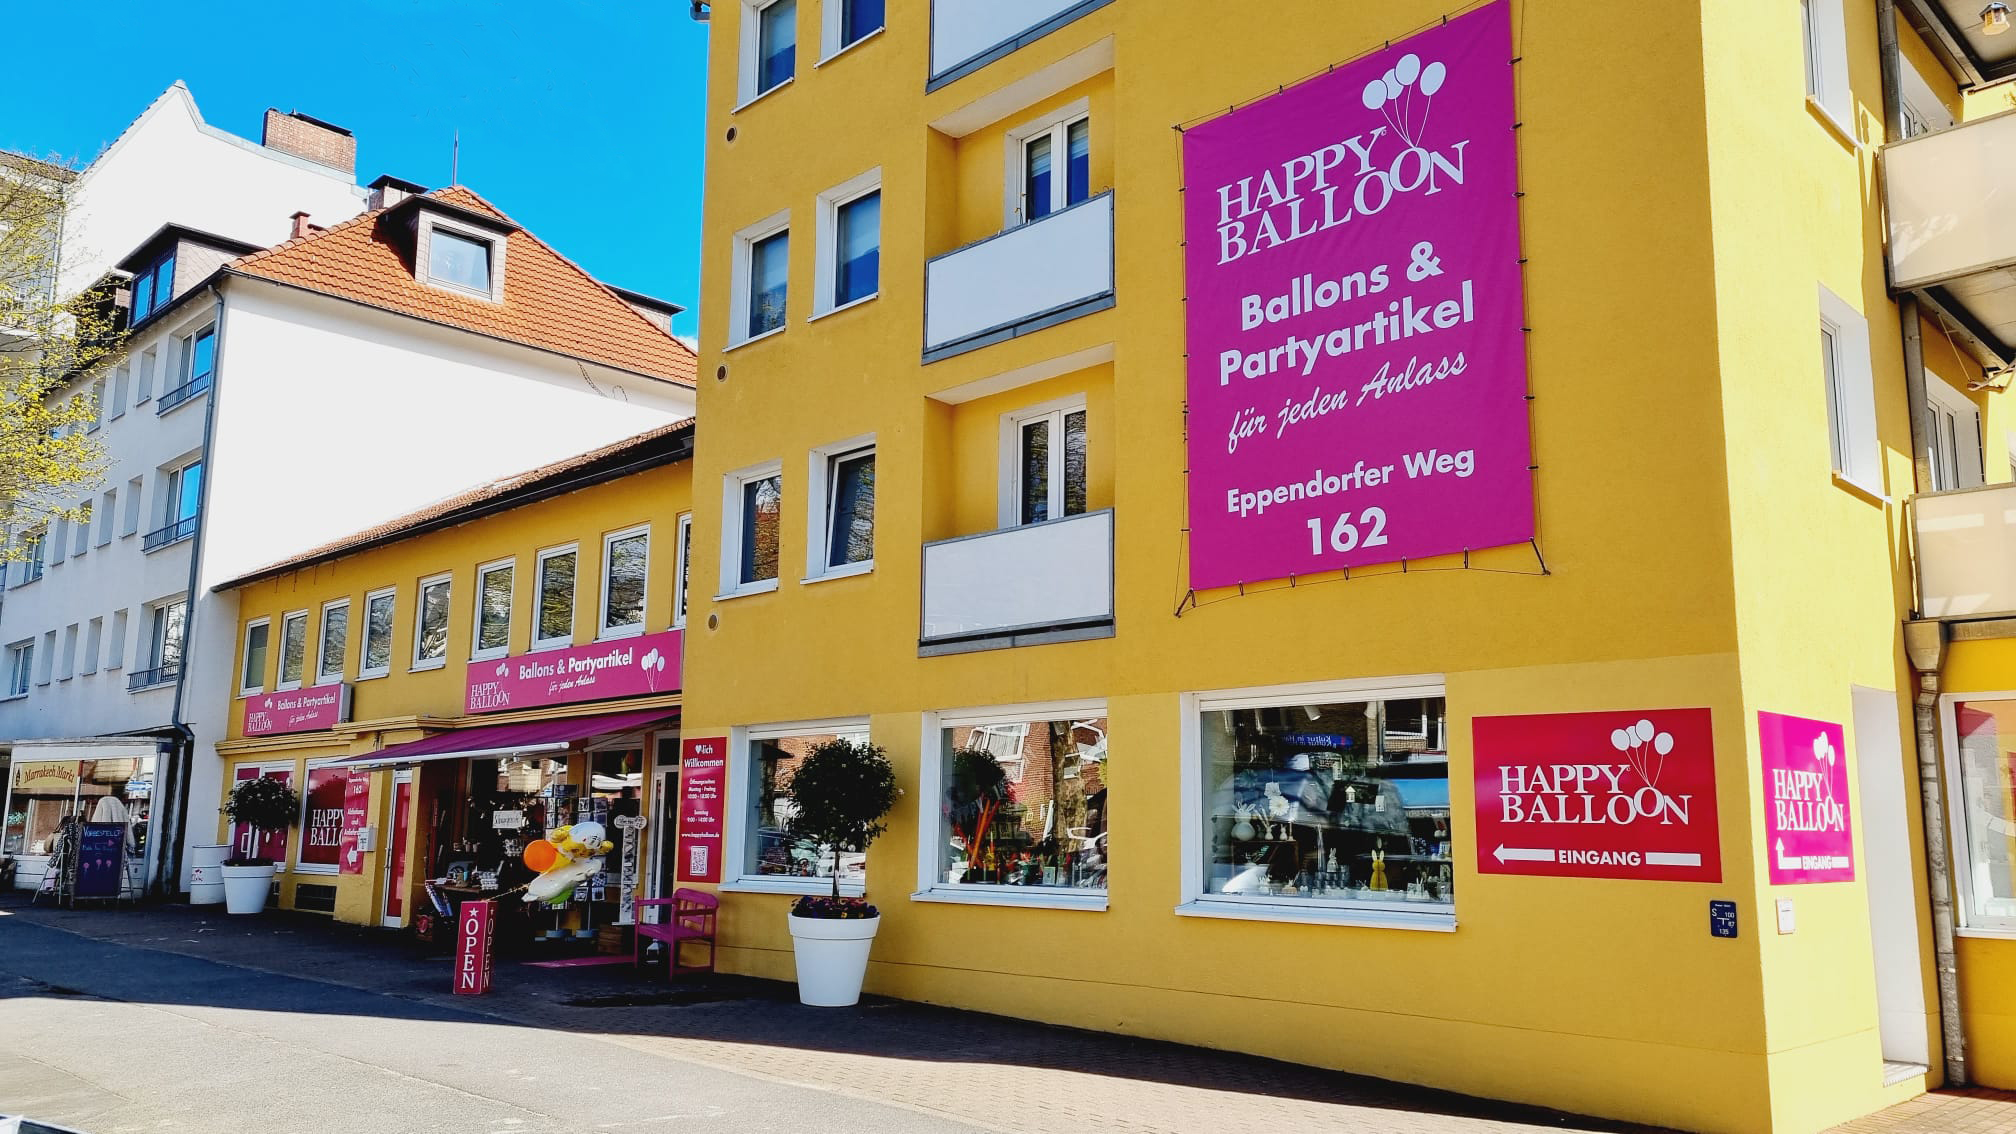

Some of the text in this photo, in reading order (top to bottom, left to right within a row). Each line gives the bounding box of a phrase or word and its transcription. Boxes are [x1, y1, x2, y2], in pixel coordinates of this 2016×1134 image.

[1217, 126, 1387, 226] HAPPY
[1217, 140, 1470, 266] BALLOON
[1242, 241, 1445, 332] Ballons &
[1220, 280, 1474, 386] Partyartikel
[1227, 351, 1468, 454] für jeden Anlass
[1227, 449, 1475, 518] Eppendorfer Weg
[1307, 506, 1388, 555] 162
[519, 647, 633, 680] Ballons & Partyartikel
[277, 692, 336, 710] Ballons & Partyartikel
[470, 689, 510, 709] BALLOON
[471, 681, 500, 697] HAPPY
[548, 681, 558, 696] für
[559, 679, 574, 695] jeden
[248, 717, 272, 732] BALLOON
[249, 711, 267, 720] HAPPY
[24, 765, 75, 783] Marrakech Markt
[684, 758, 724, 768] Willkommen
[1498, 764, 1630, 794] HAPPY
[1772, 768, 1824, 801] HAPPY
[1500, 786, 1693, 825] BALLOON
[1775, 796, 1845, 832] BALLOON
[1558, 849, 1641, 866] EINGANG
[1802, 855, 1832, 870] EINGANG
[1711, 908, 1718, 917] S
[461, 918, 479, 988] OPEN
[483, 918, 494, 989] OPEN
